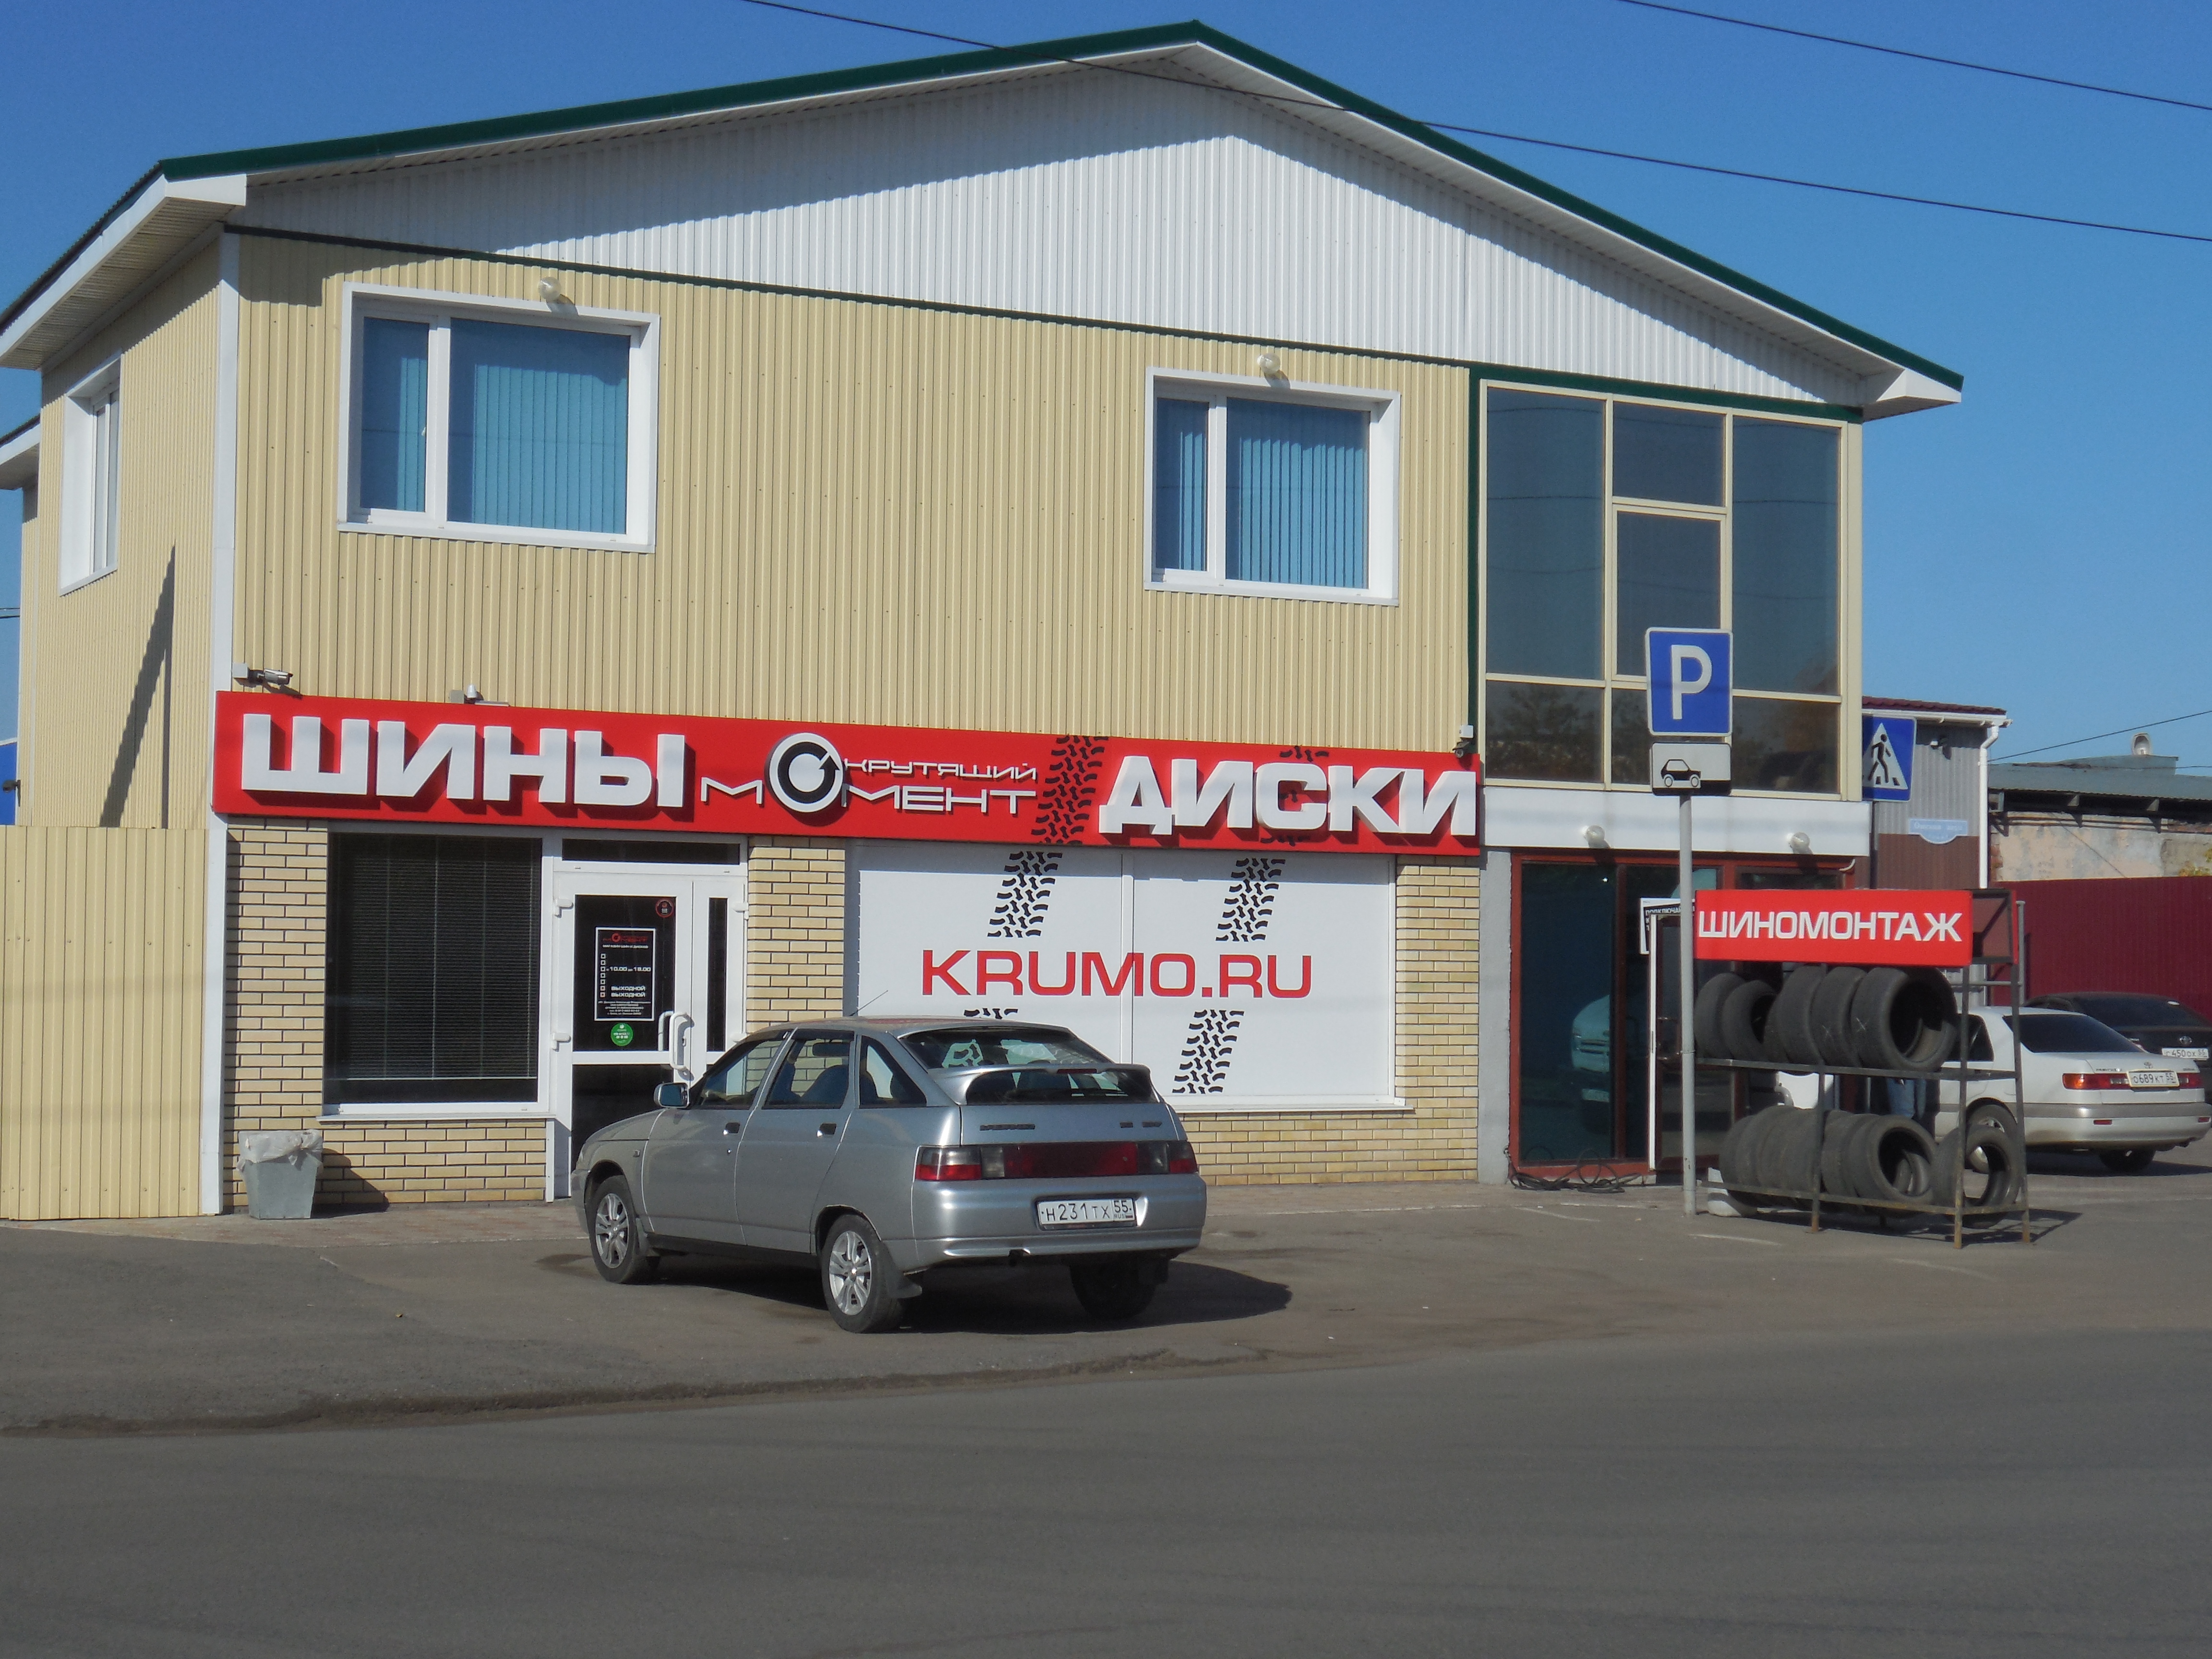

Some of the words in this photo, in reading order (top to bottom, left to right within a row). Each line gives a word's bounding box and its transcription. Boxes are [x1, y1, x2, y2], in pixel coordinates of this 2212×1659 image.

[1671, 644, 1713, 720] P
[241, 713, 685, 807] ШИНЫ
[1099, 756, 1476, 836] ДИСКИ
[1698, 911, 1963, 942] ШИНОМОНТАЖ
[922, 949, 1312, 998] KRUMO.RU
[1113, 1200, 1128, 1213] 55
